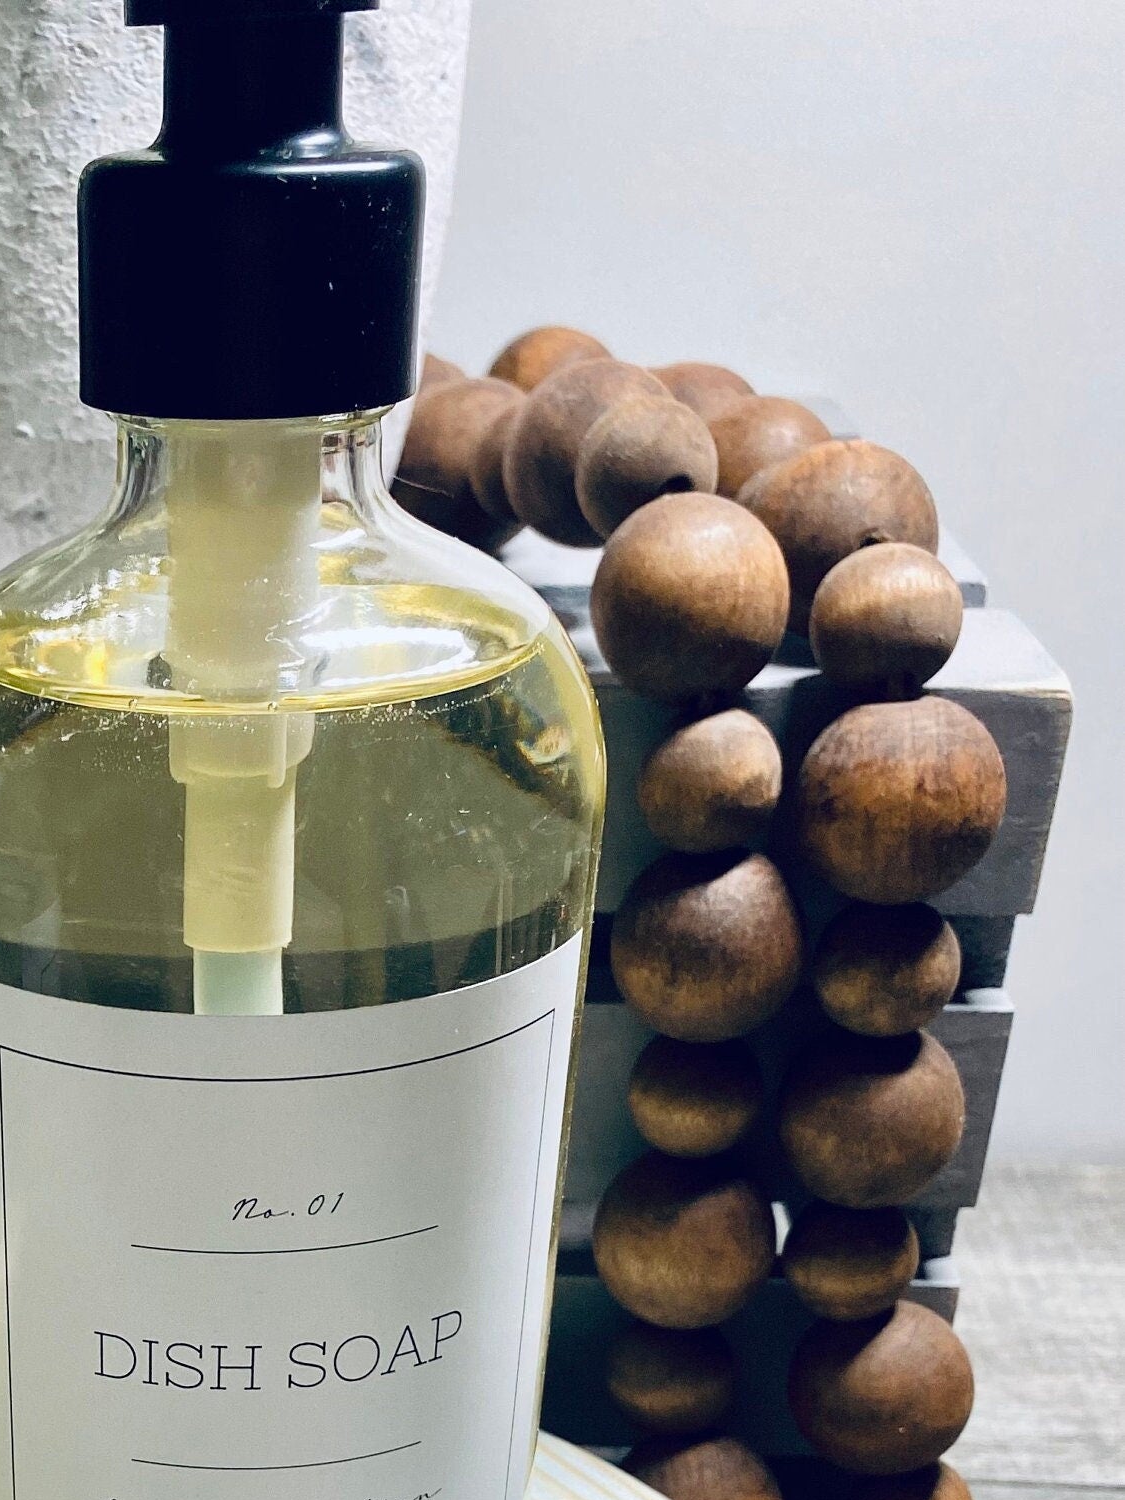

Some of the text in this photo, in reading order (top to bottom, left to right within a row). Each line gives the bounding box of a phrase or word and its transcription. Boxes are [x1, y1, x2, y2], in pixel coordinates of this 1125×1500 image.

[232, 1192, 345, 1221] No. 01
[93, 1310, 463, 1391] DISH SOAP
